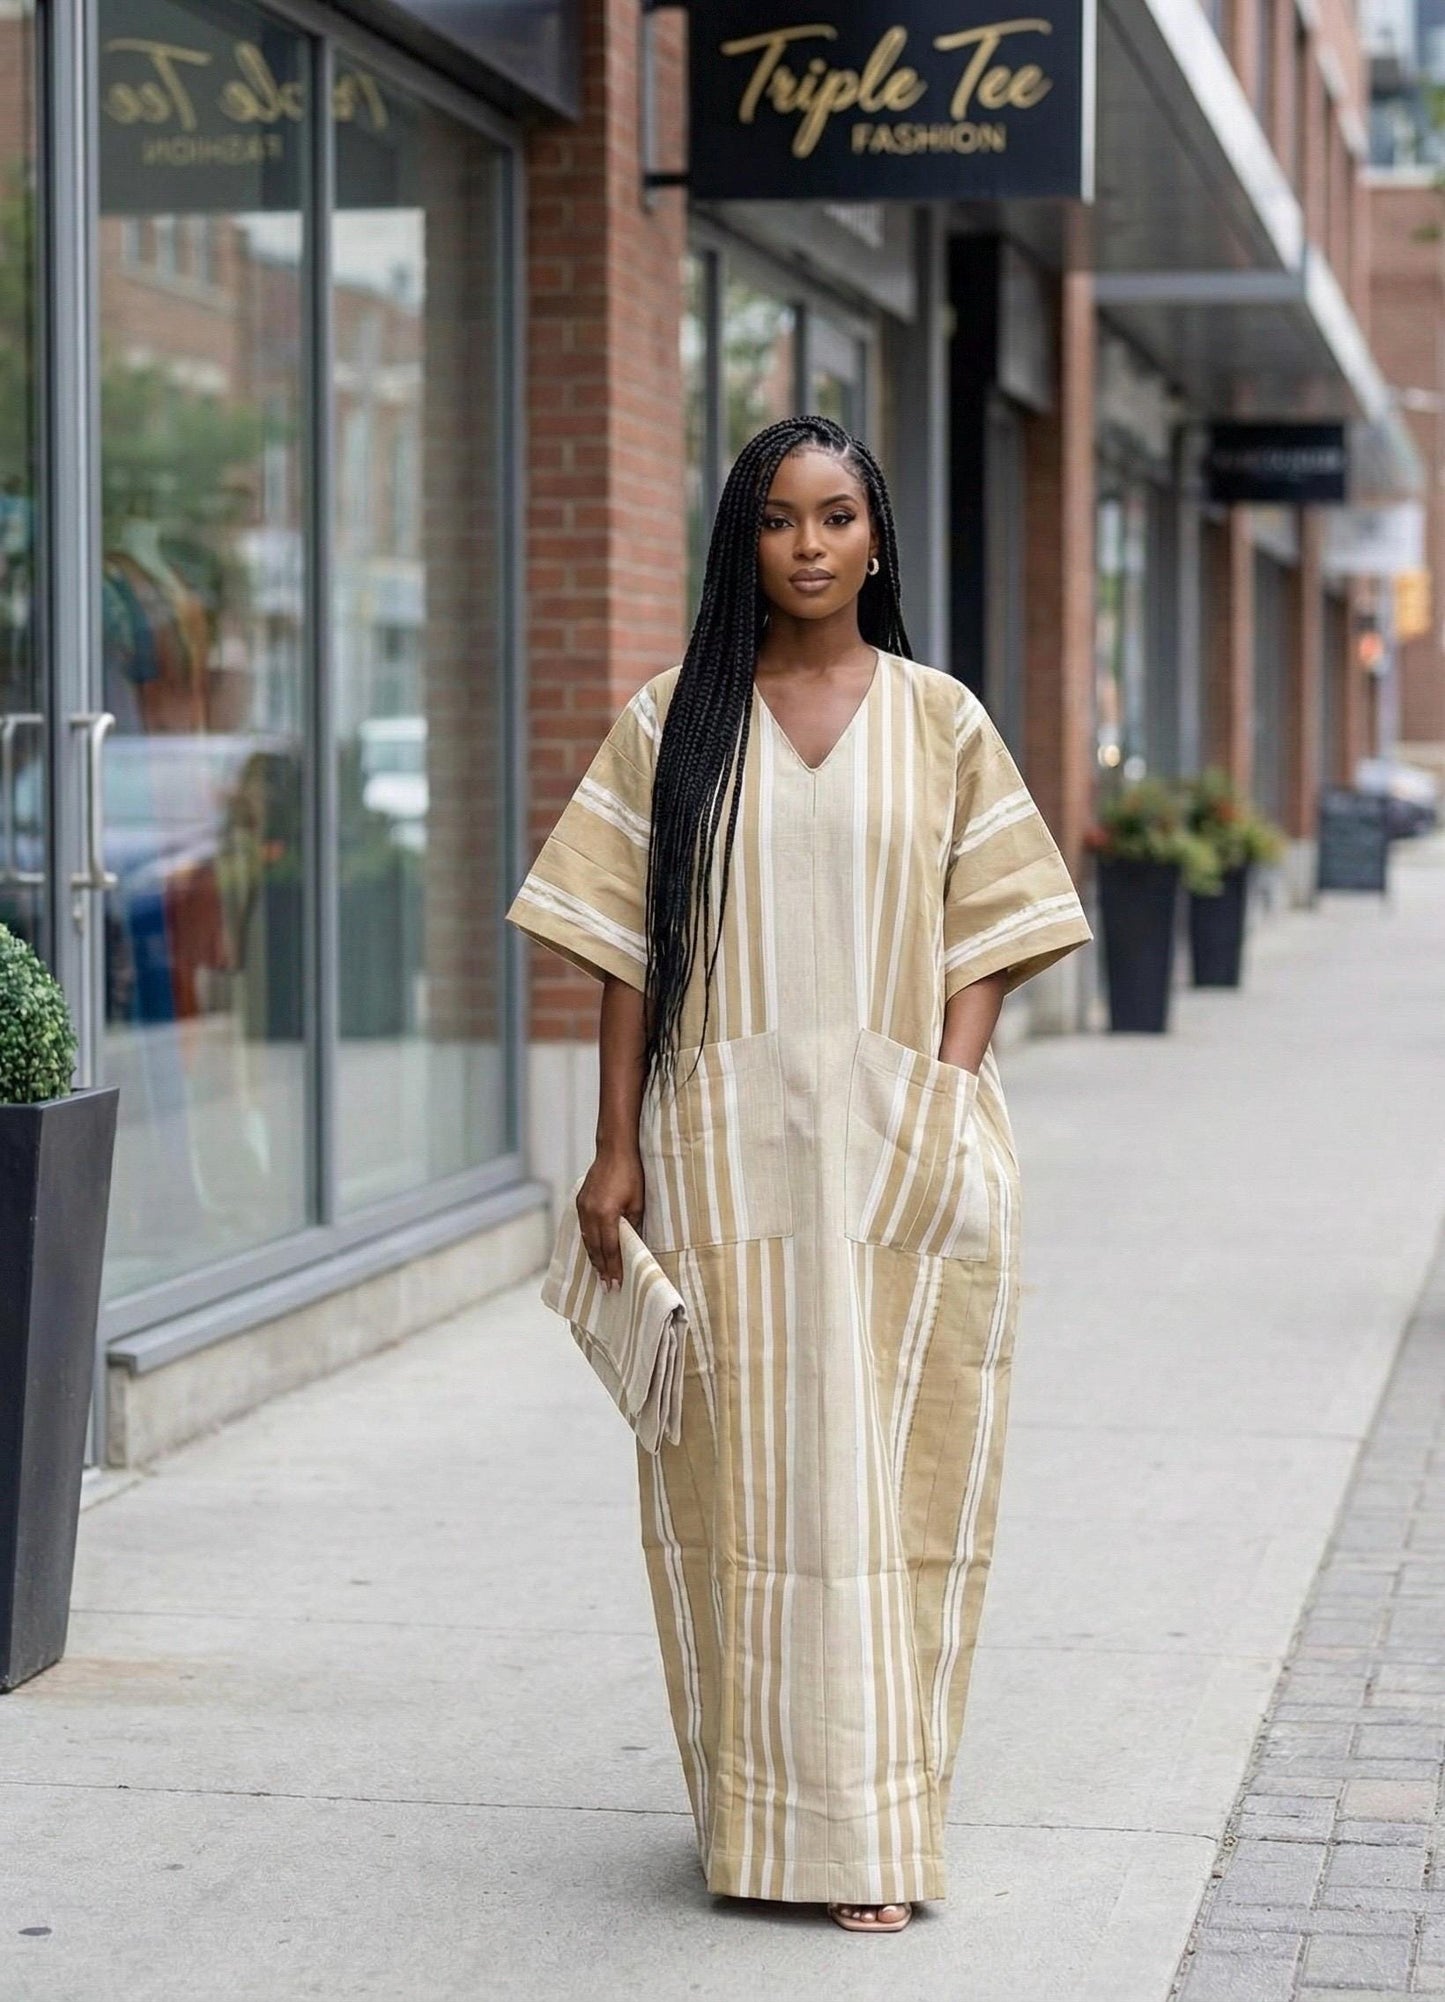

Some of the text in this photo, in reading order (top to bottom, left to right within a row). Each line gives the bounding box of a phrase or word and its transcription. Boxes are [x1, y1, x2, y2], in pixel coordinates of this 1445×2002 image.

[721, 18, 1053, 159] Triple Tee
[851, 122, 1007, 155] FASHION
